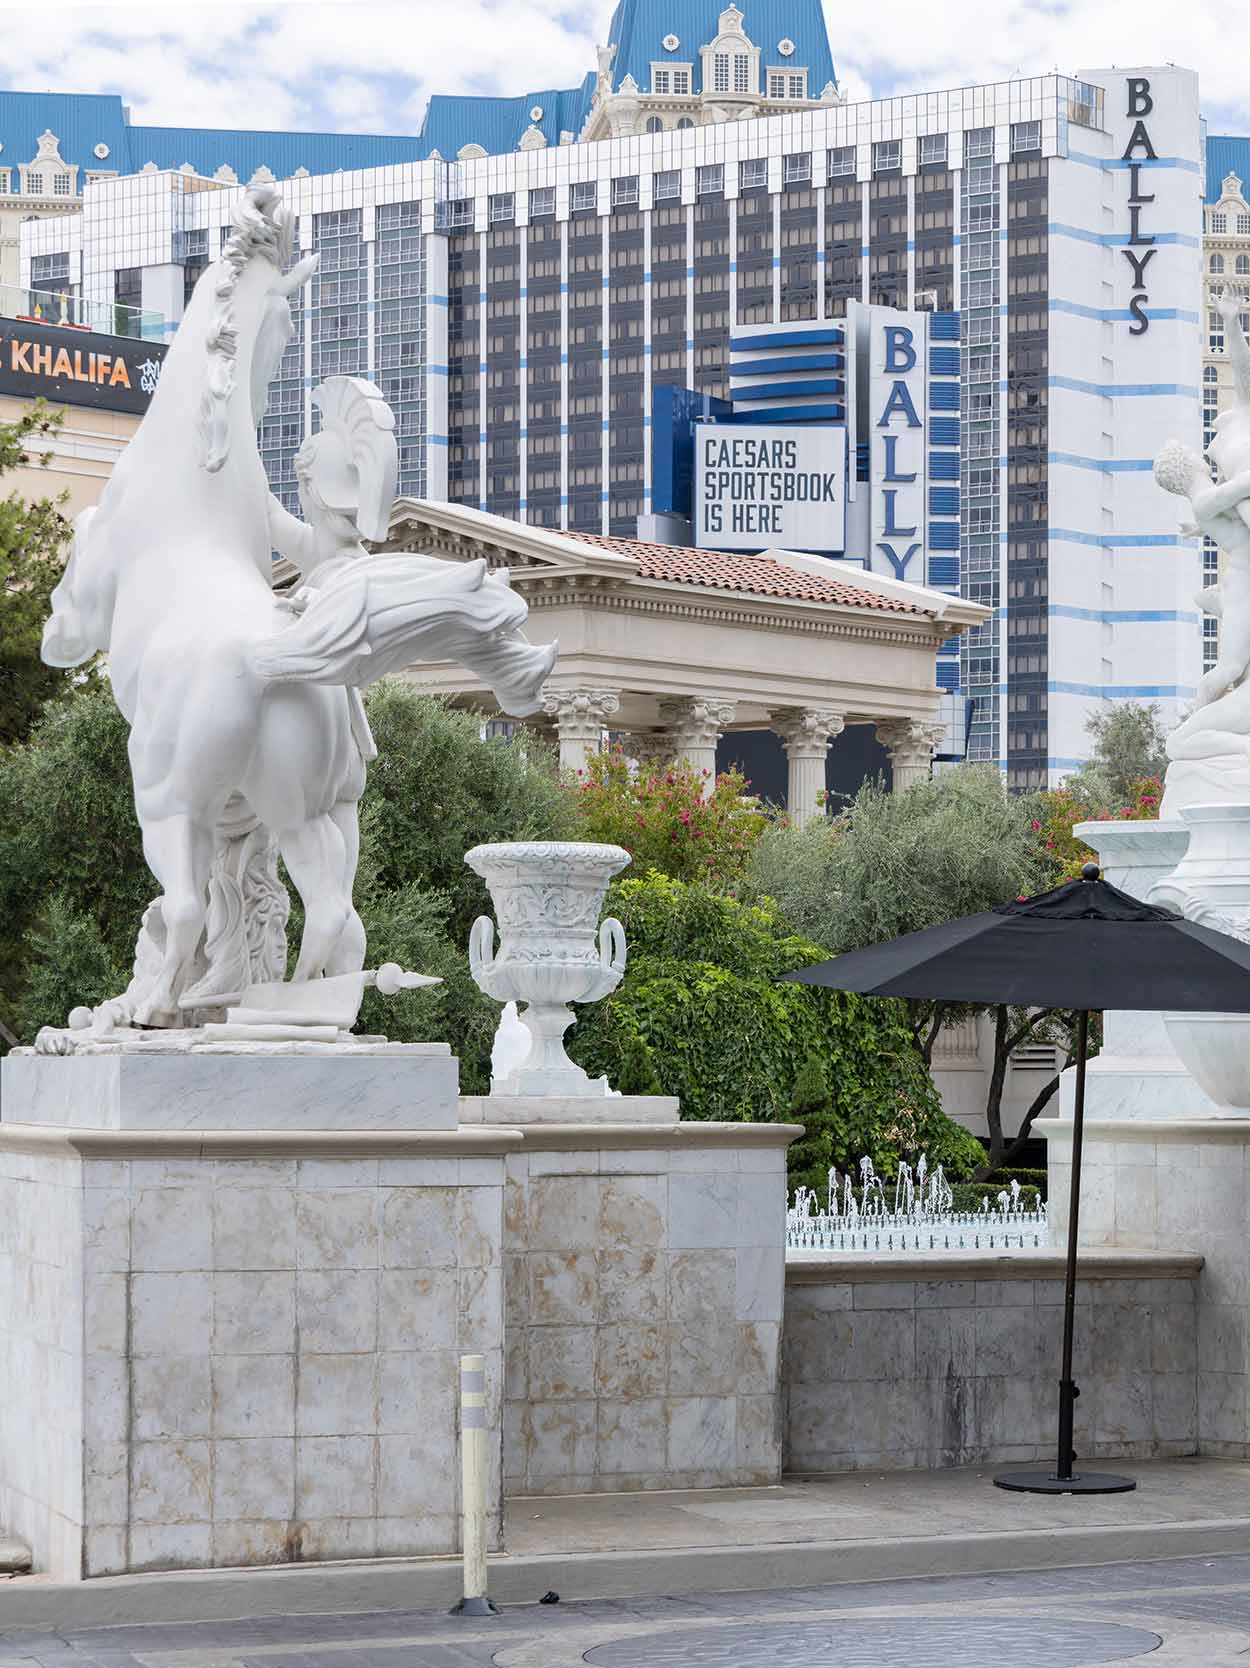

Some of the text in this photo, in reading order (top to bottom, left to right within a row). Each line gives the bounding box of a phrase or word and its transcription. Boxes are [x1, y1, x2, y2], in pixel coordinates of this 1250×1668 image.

[1121, 78, 1159, 336] BALLYS
[11, 340, 131, 389] KHALIFA
[705, 439, 797, 469] CAESARS
[876, 326, 923, 582] BALLY
[705, 471, 836, 502] SPORTSBOOK
[705, 503, 783, 533] IS HERE
